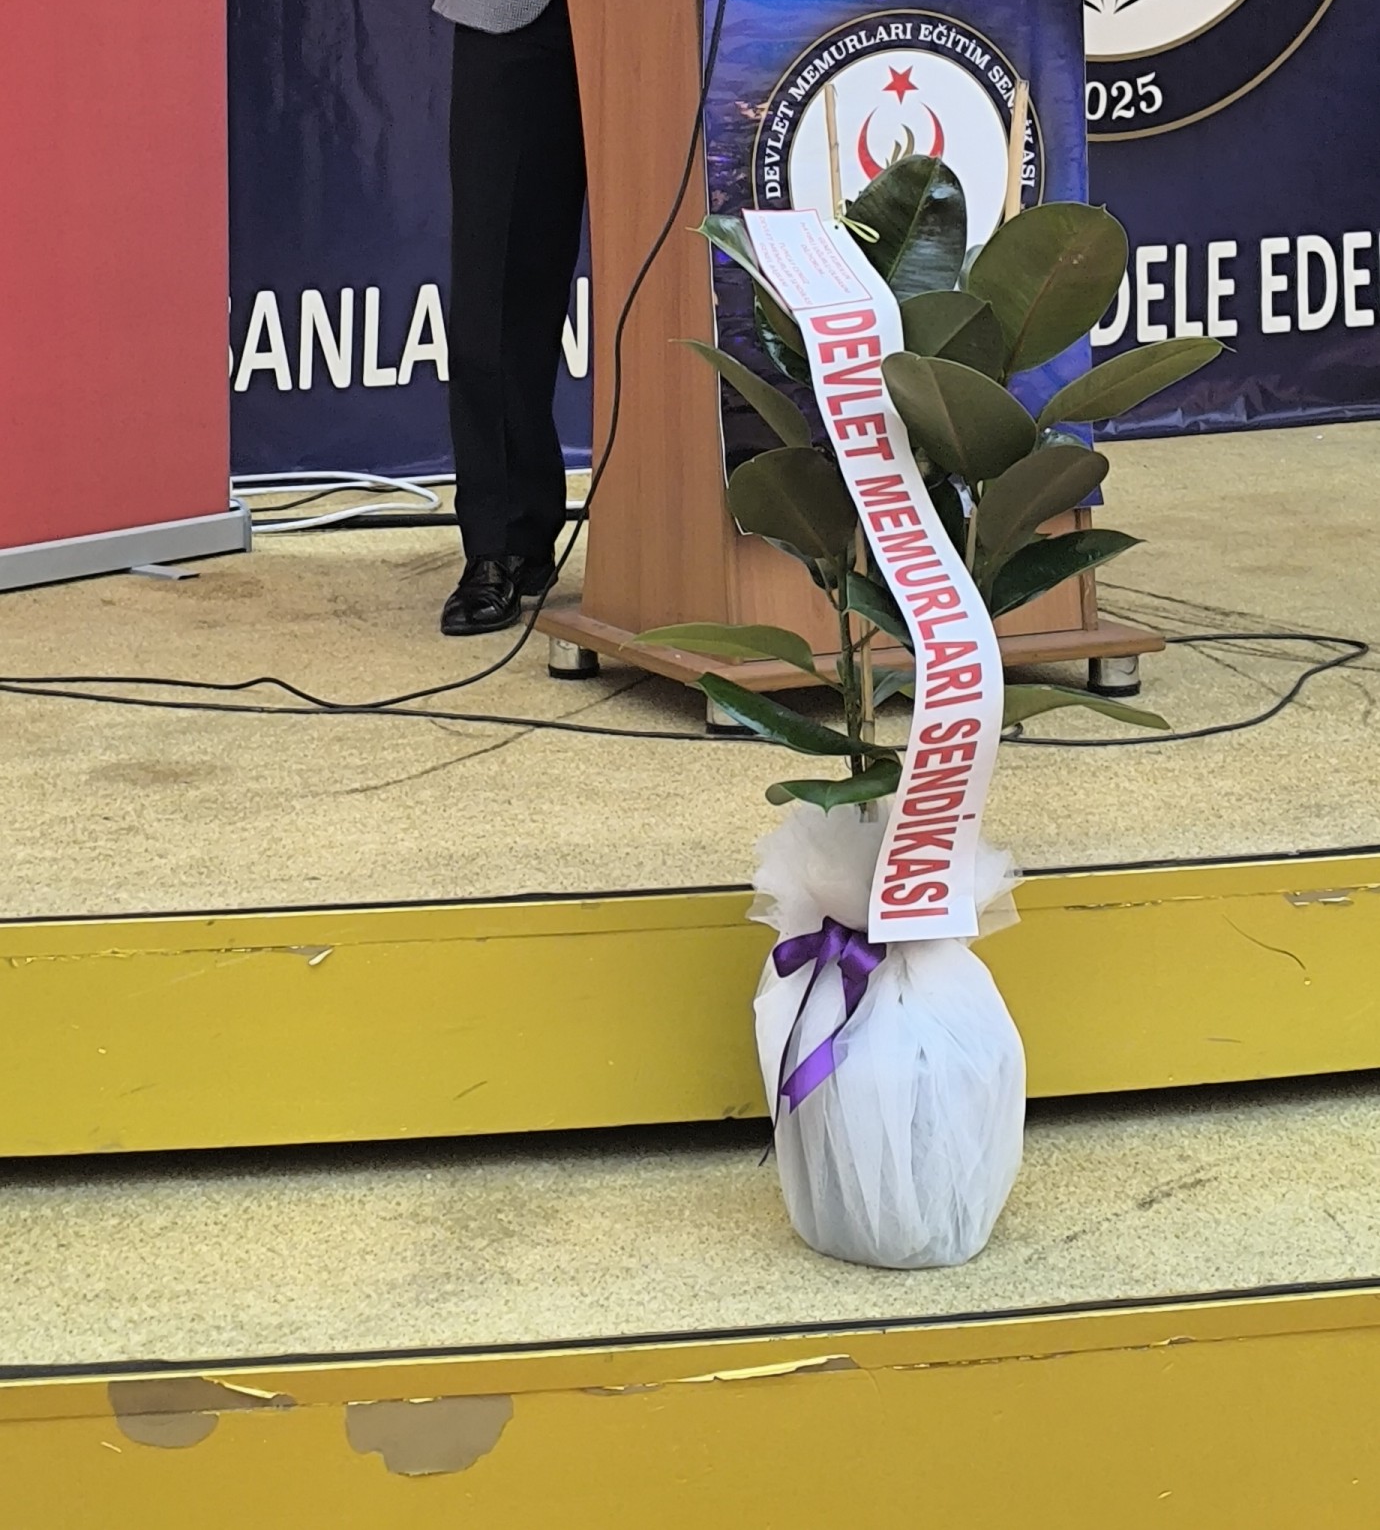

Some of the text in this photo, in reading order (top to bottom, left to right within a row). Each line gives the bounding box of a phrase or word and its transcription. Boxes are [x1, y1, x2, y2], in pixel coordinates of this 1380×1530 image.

[764, 101, 795, 199] DEVLET
[788, 22, 913, 102] MEMURLARI
[918, 23, 991, 70] EĞİTİM
[1085, 71, 1164, 121] 025
[1260, 231, 1380, 334] EDE
[810, 308, 983, 921] DEVLET MEMURLARI SENDİKASI
